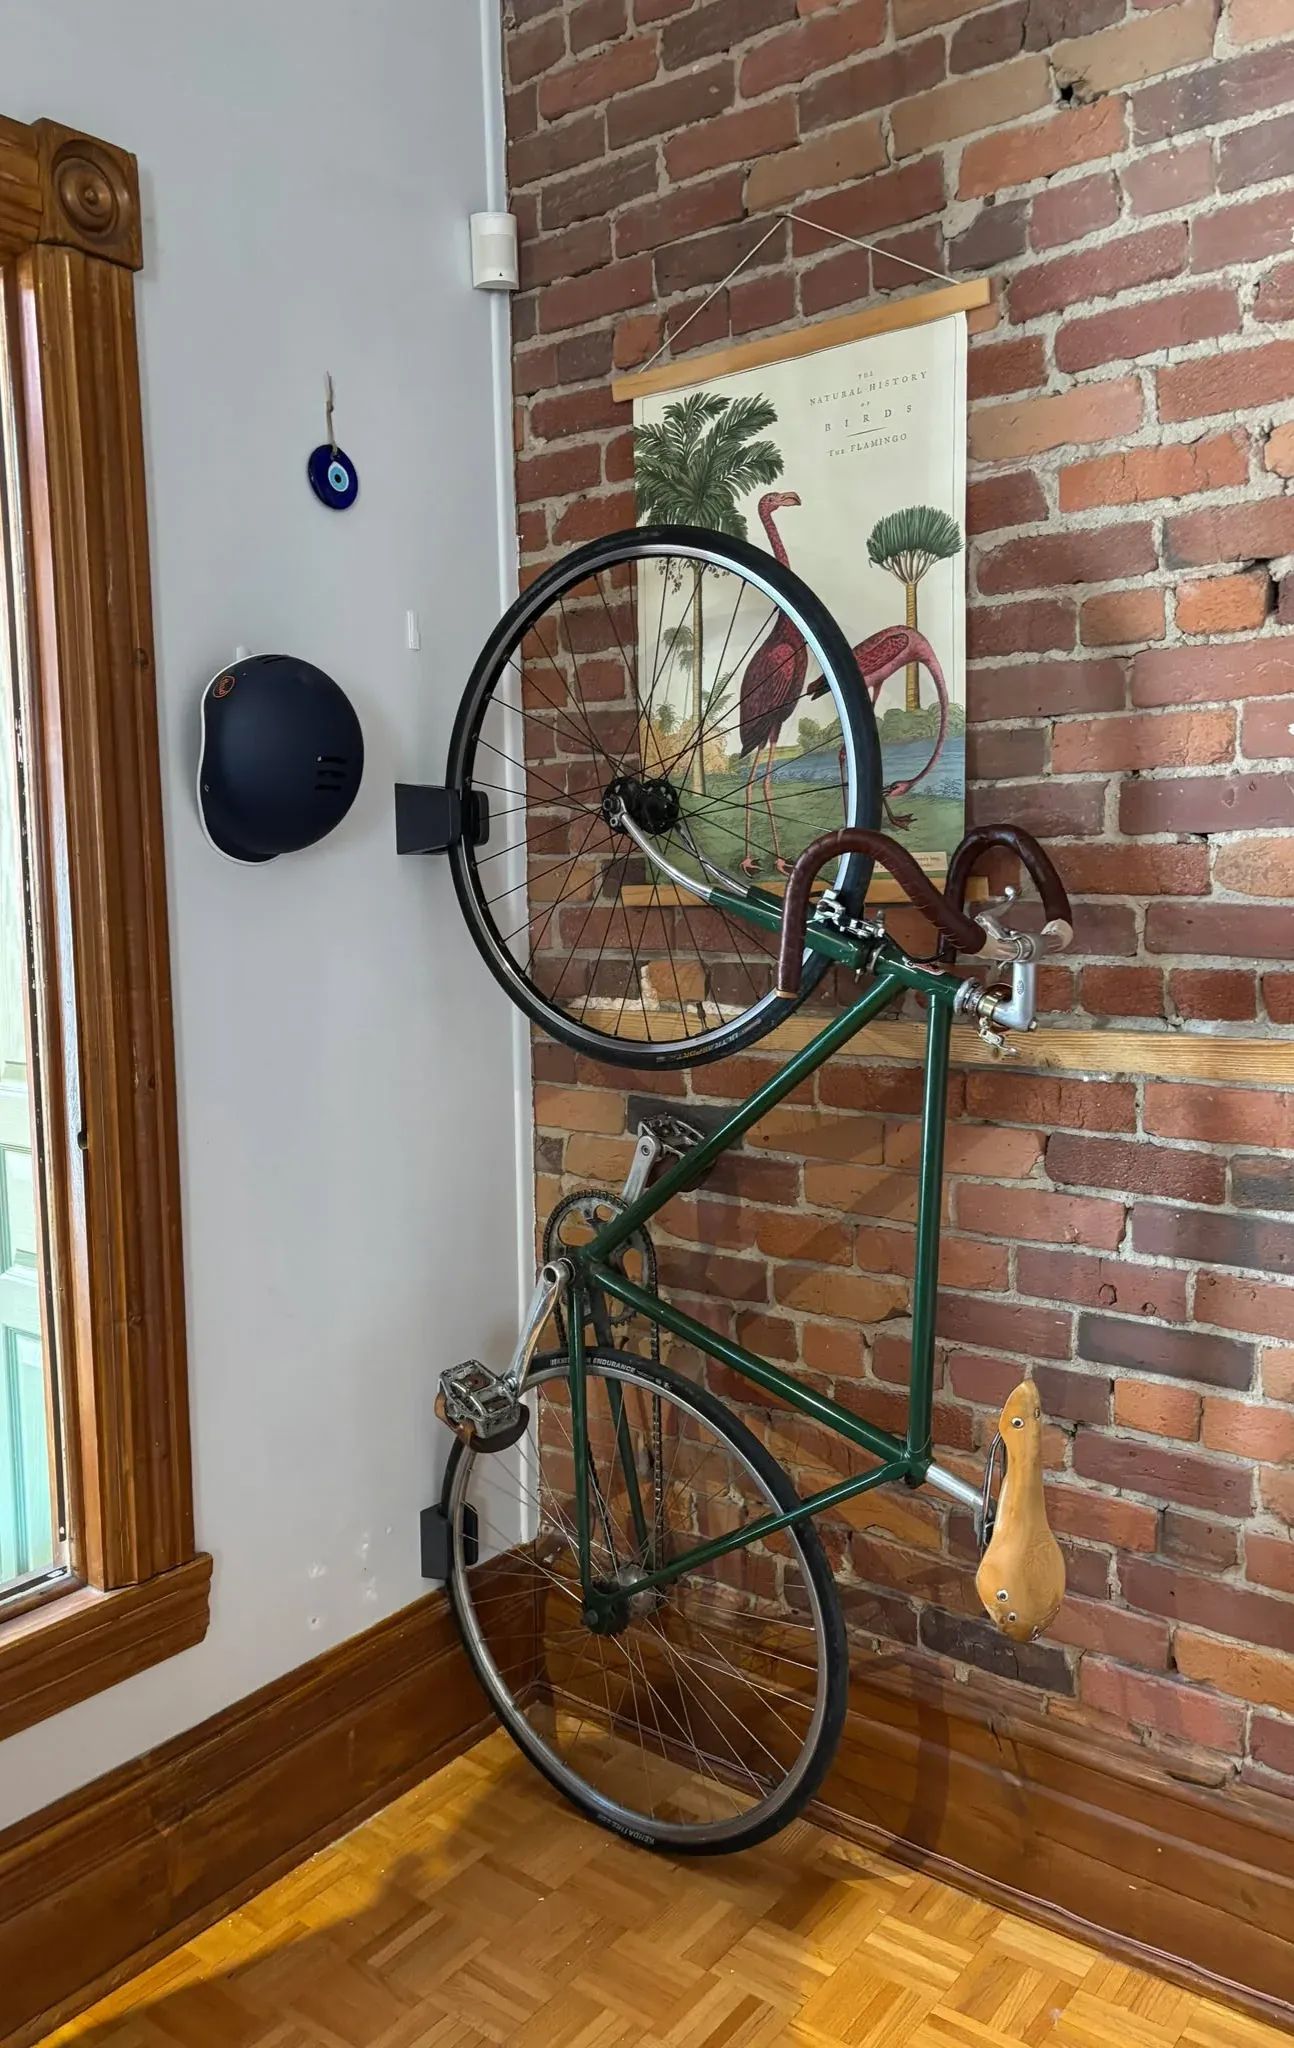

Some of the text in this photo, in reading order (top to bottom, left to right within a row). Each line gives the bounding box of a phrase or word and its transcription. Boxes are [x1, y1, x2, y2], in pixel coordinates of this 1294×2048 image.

[858, 371, 874, 380] THE
[809, 371, 927, 406] NATURAL HISTORY
[860, 400, 871, 408] OF
[825, 404, 912, 432] BIRDS
[850, 433, 907, 452] FLAMINGO
[592, 1357, 636, 1374] ENDURANCE
